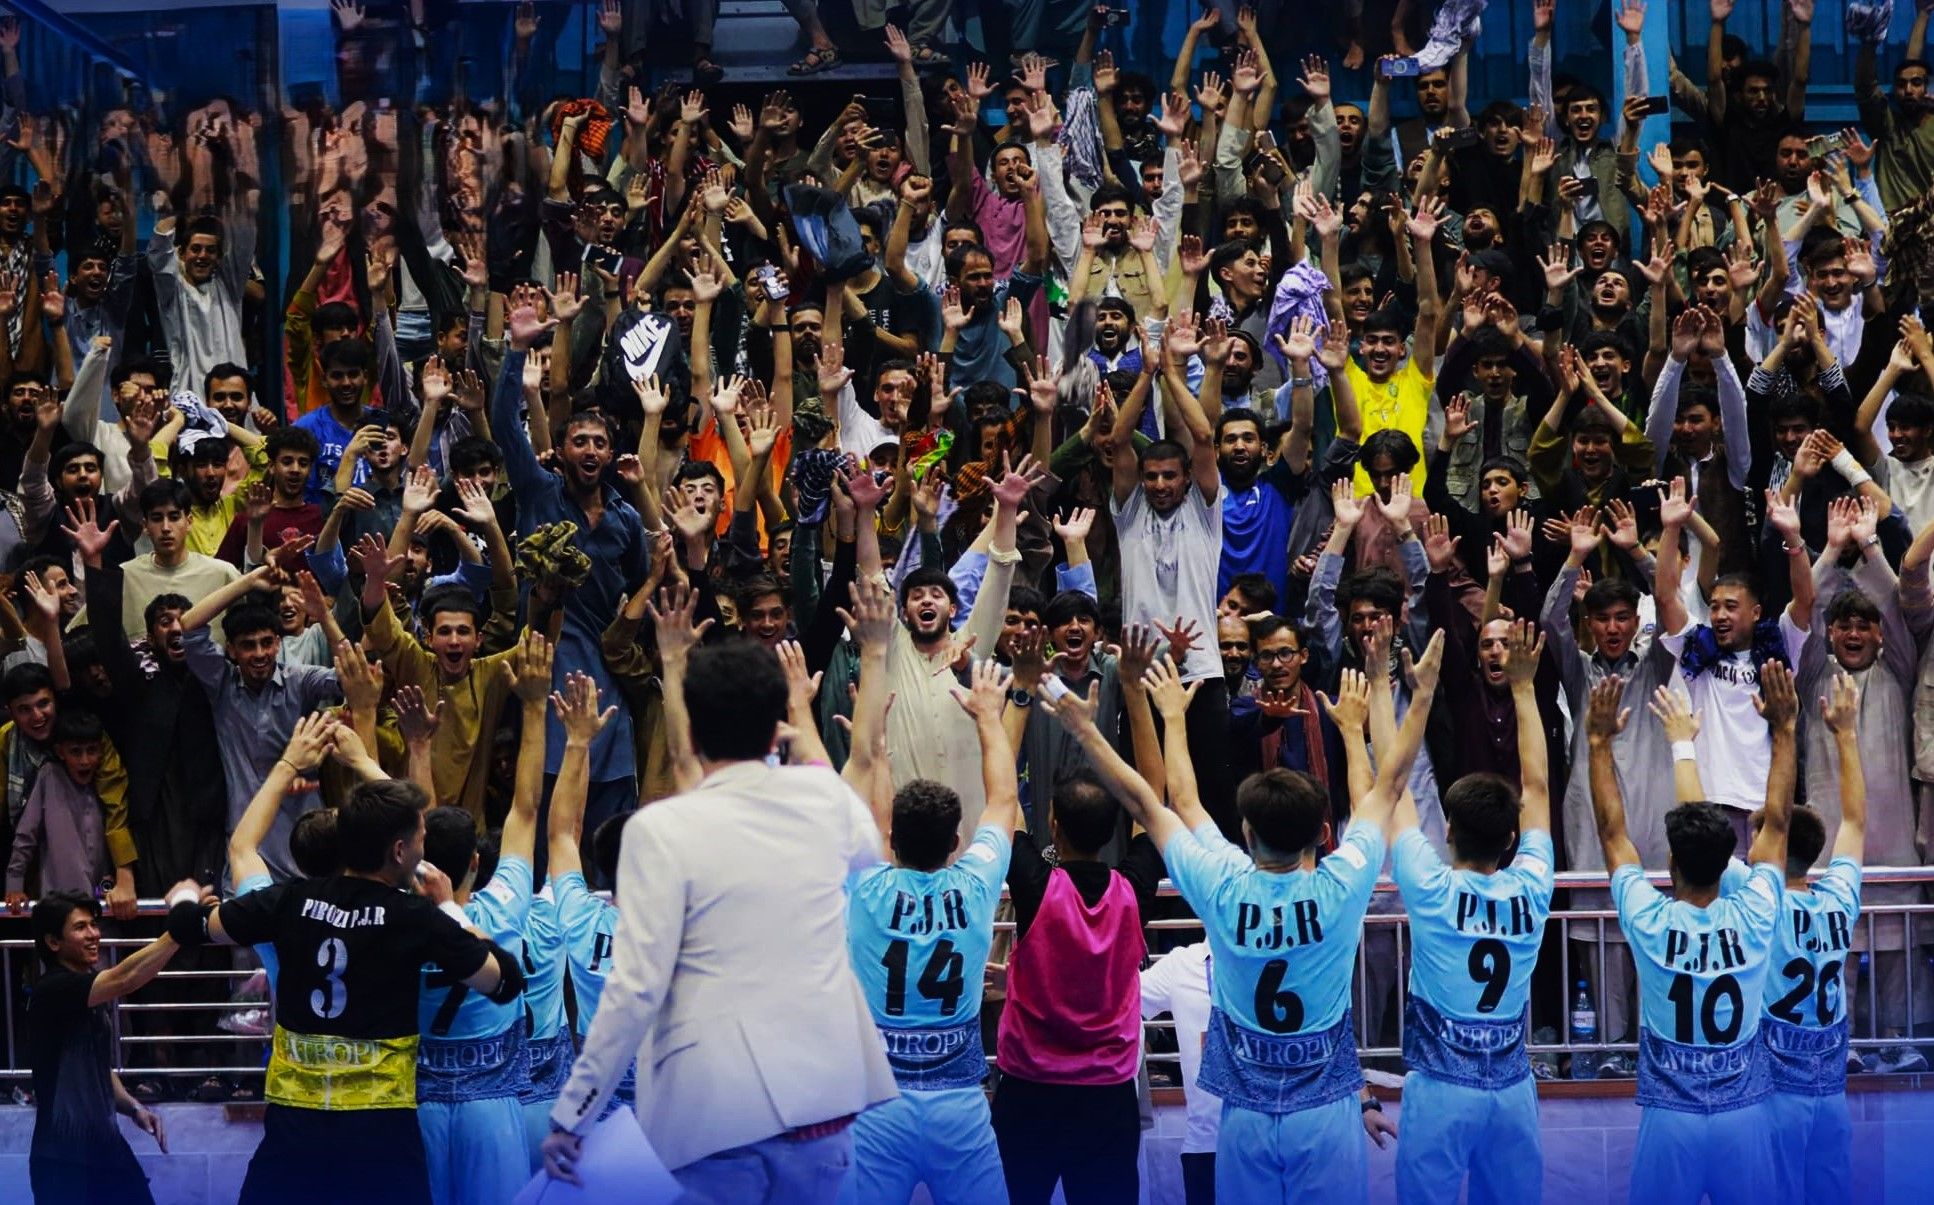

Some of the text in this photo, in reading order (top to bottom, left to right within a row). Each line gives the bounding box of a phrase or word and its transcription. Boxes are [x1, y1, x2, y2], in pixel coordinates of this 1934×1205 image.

[620, 314, 660, 362] NIKE
[350, 906, 386, 928] P.J.R
[888, 889, 968, 936] P.J.R
[1235, 899, 1324, 950] P.J.R
[1457, 892, 1534, 936] P.J.R
[311, 938, 348, 1019] 3
[881, 939, 964, 1016] 14
[1468, 938, 1511, 1013] 9
[1665, 928, 1747, 973] P.J.R
[1254, 959, 1304, 1034] 6
[1668, 973, 1744, 1045] 10
[1768, 957, 1842, 1026] 20
